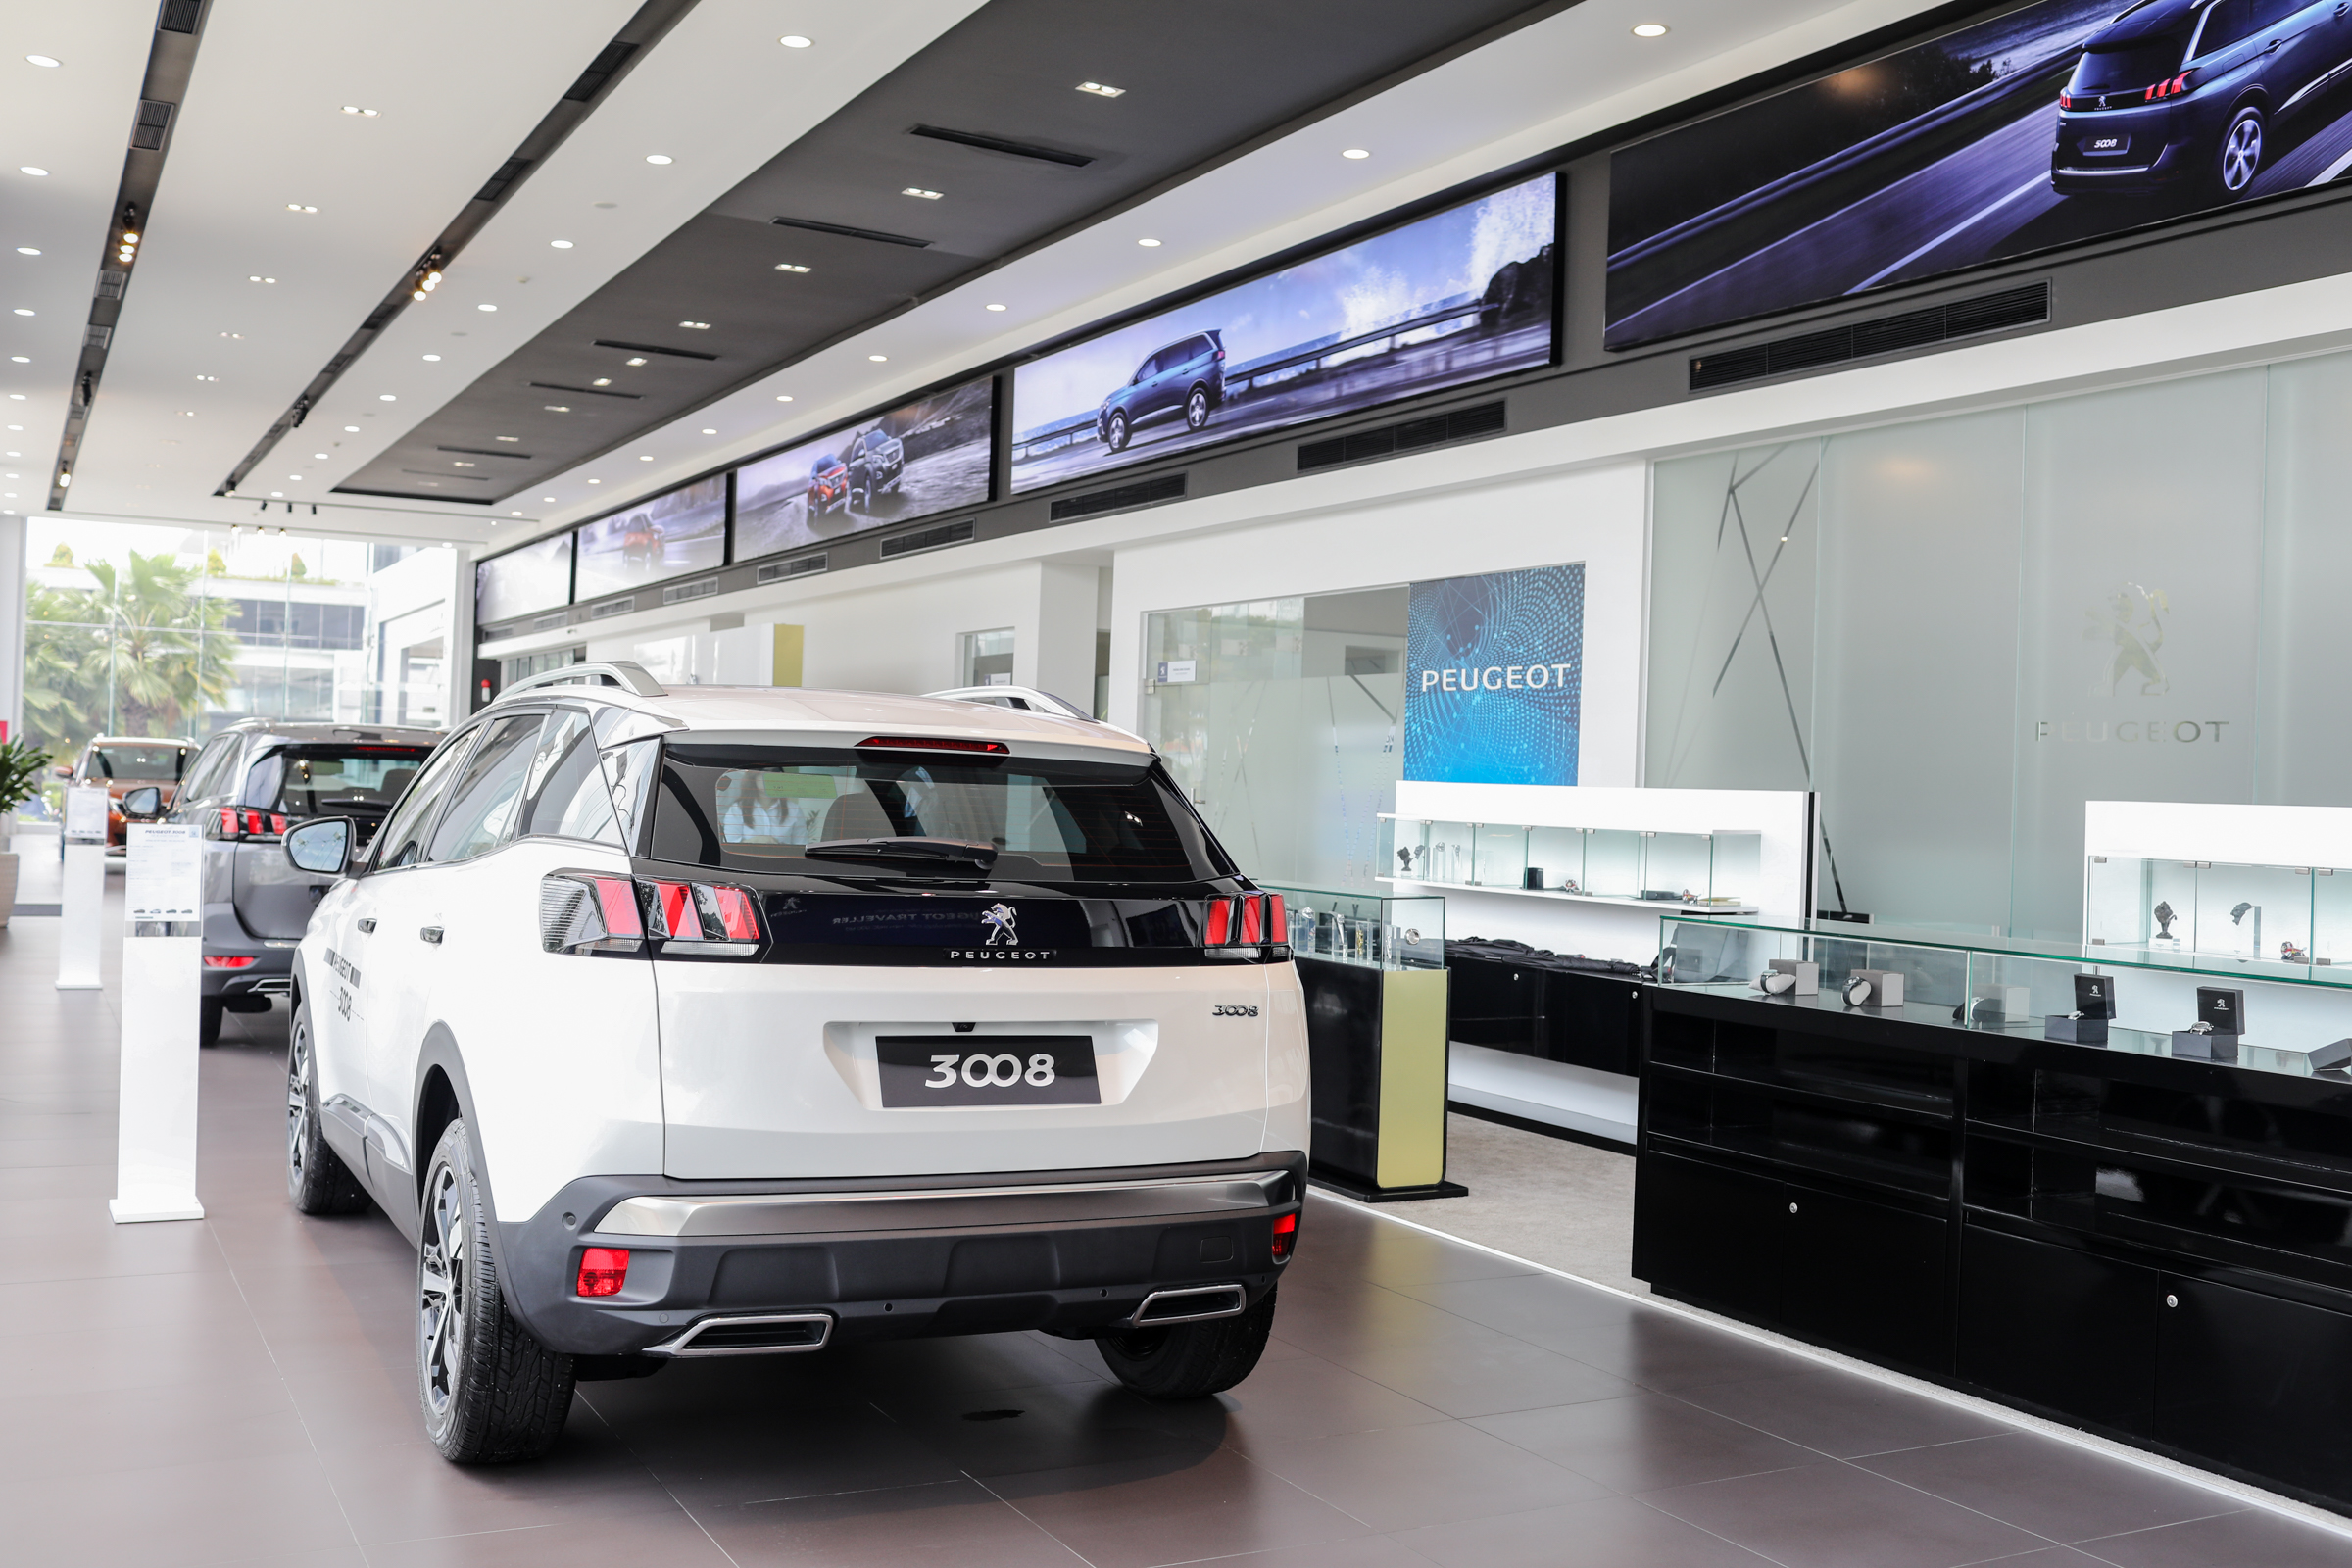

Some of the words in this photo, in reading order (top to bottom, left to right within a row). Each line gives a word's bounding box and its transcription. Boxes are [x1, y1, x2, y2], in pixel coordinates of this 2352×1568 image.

[2093, 138, 2118, 148] 5008
[1422, 663, 1571, 692] PEUGEOT
[2035, 720, 2230, 743] PEUGEOT
[950, 951, 1050, 959] PEUGEOT
[1212, 1004, 1259, 1017] 3008
[924, 1054, 1055, 1089] 3008
